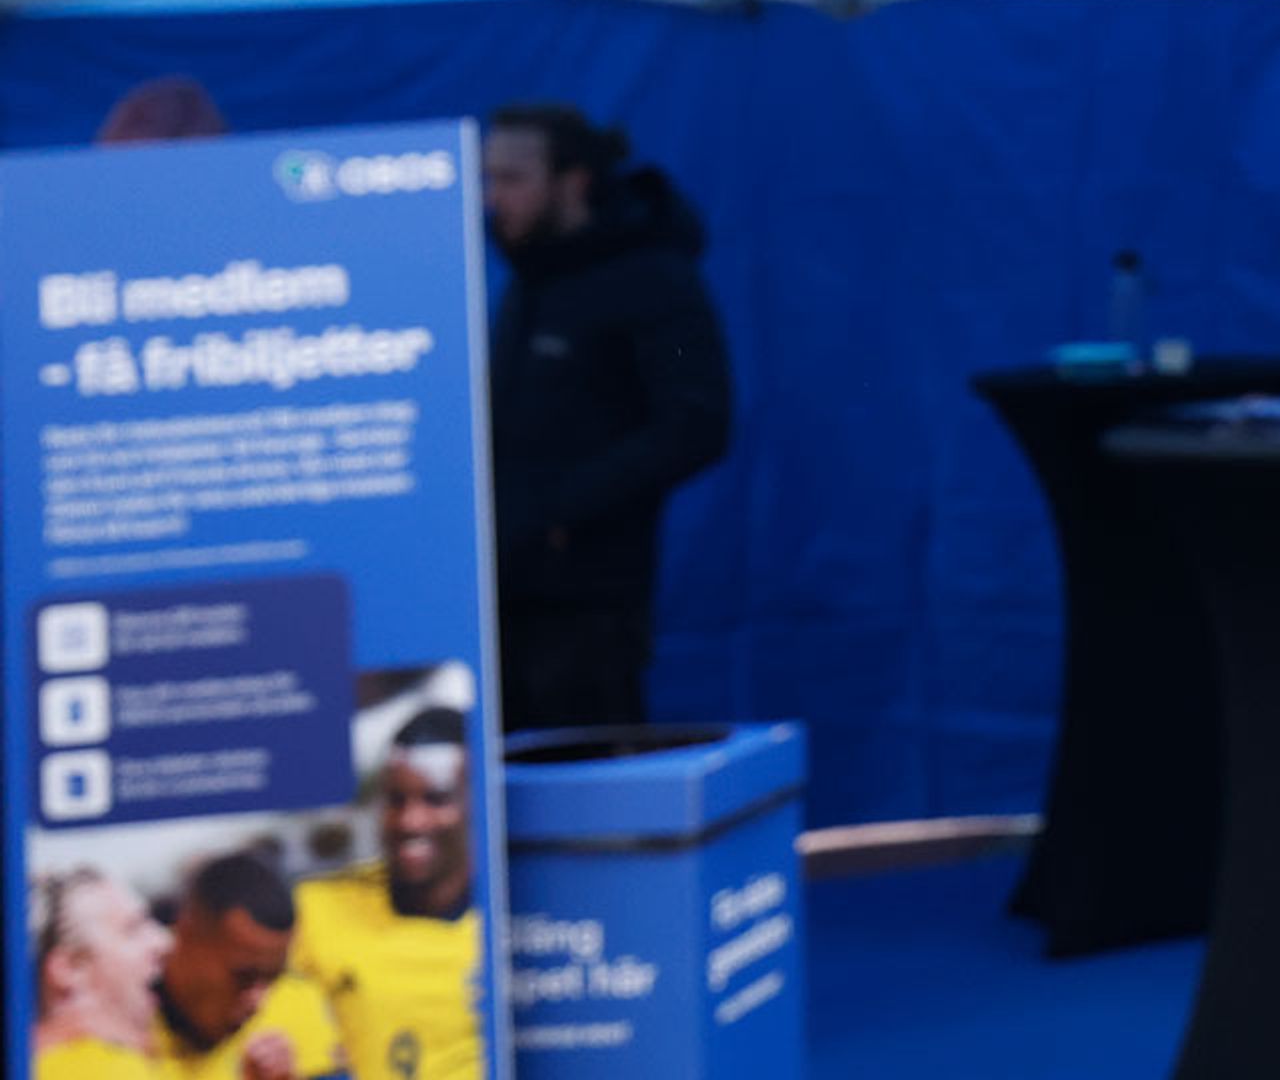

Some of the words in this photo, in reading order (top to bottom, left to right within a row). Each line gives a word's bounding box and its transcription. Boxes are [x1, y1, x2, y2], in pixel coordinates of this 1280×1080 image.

[336, 150, 456, 196] OBOS
[39, 271, 118, 329] Bli
[121, 260, 350, 321] medlem
[74, 336, 140, 397] få
[141, 324, 434, 390] fribiljetter
